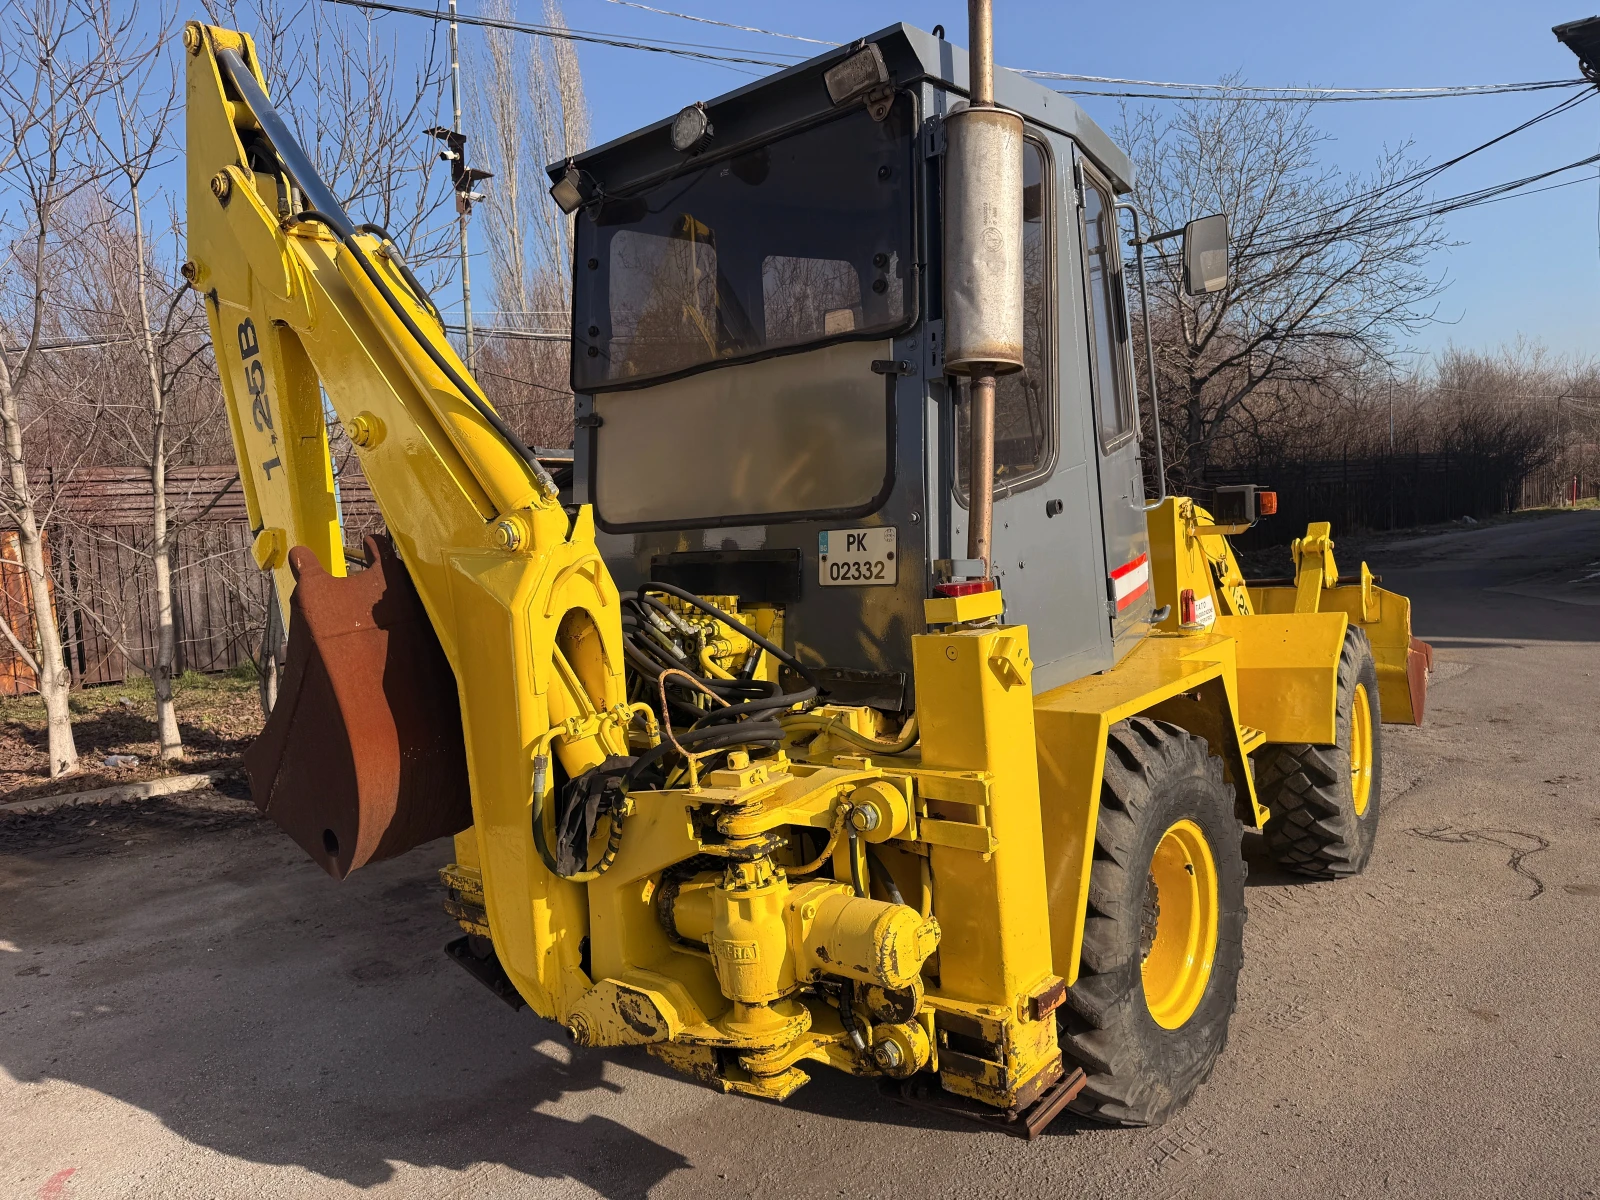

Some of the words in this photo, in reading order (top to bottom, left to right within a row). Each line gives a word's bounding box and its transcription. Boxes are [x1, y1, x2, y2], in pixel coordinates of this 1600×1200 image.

[820, 544, 828, 552] BG
[846, 532, 868, 552] PK
[829, 560, 885, 581] 02332
